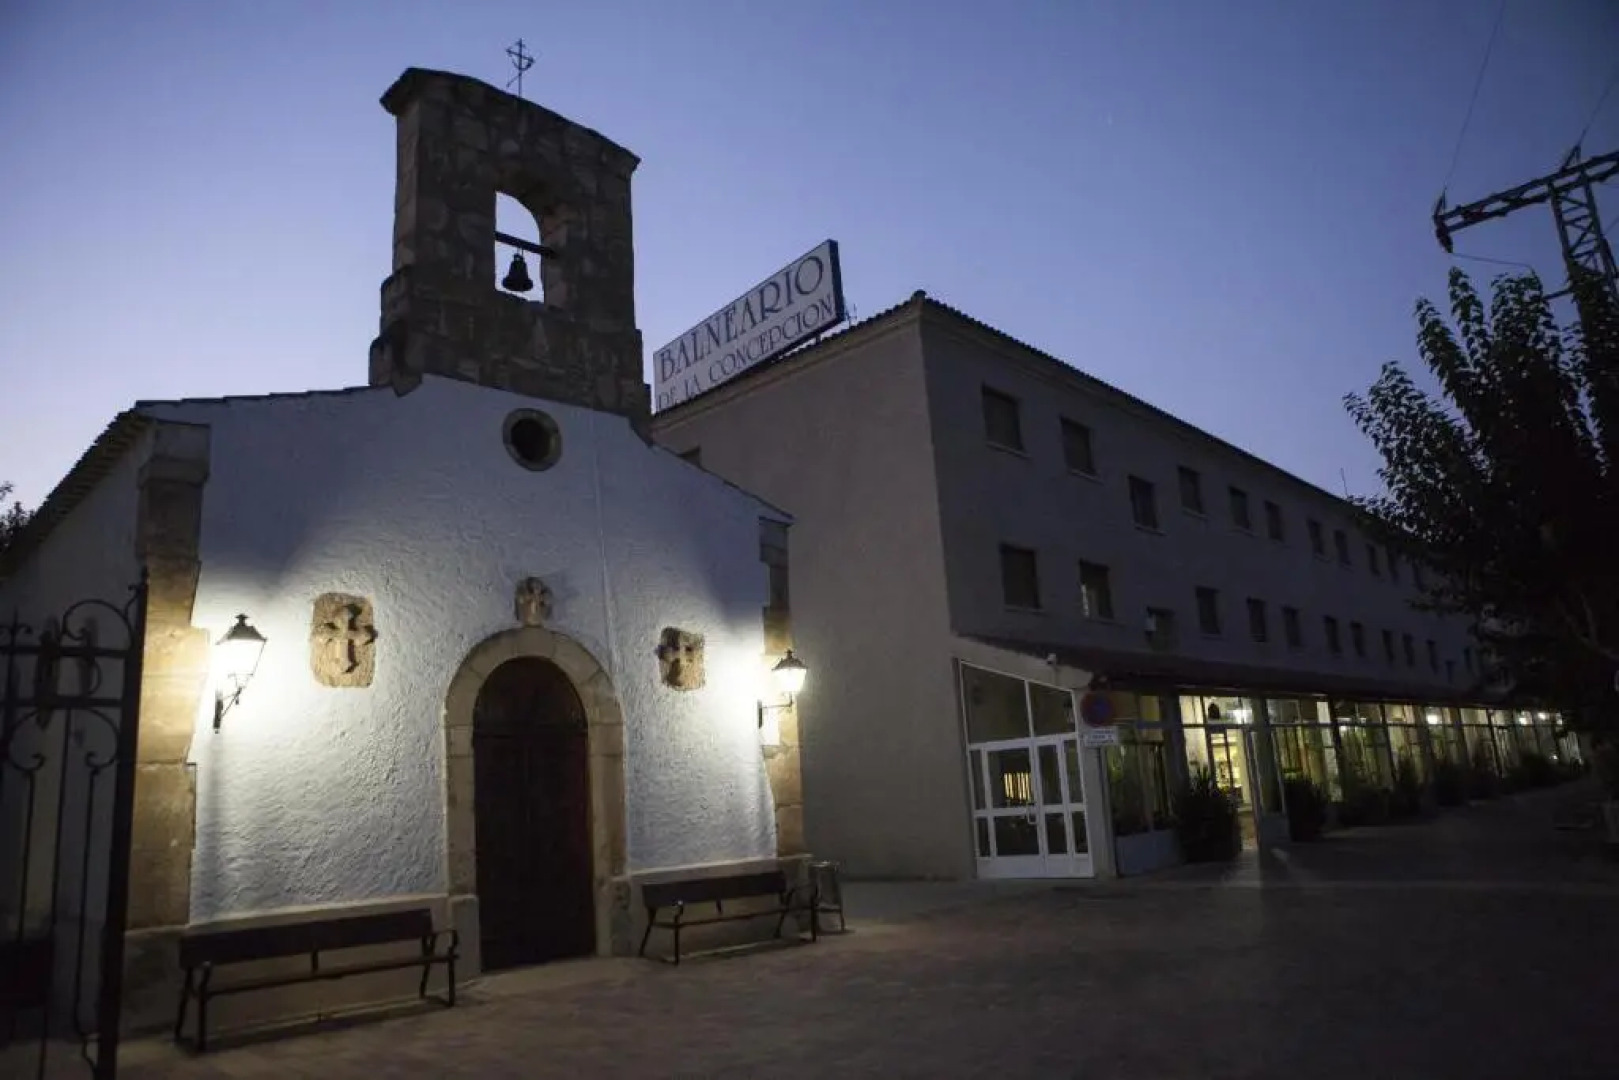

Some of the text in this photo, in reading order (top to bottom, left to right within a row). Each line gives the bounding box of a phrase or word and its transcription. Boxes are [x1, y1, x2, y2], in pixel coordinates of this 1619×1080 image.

[657, 293, 834, 410] DE LA CONCEPCION
[660, 255, 823, 383] BALNEARIO
